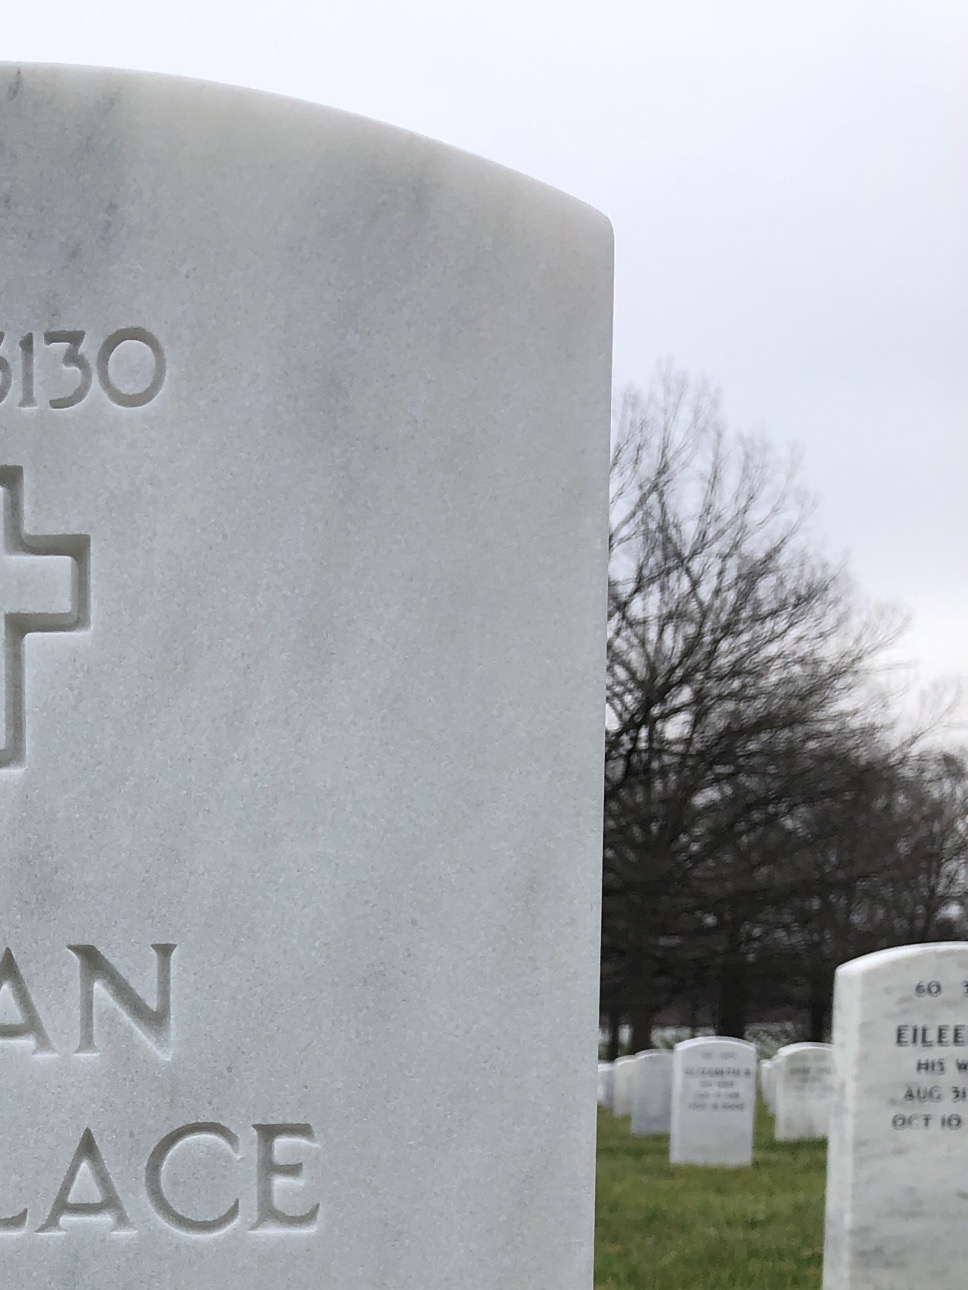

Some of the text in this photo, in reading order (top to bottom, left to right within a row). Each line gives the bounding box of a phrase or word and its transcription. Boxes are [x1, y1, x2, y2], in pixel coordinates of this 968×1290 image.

[914, 979, 942, 998] 60
[896, 1024, 967, 1047] EILEE
[916, 1058, 946, 1075] HIS
[904, 1085, 943, 1103] AUG
[892, 1113, 932, 1131] OCT
